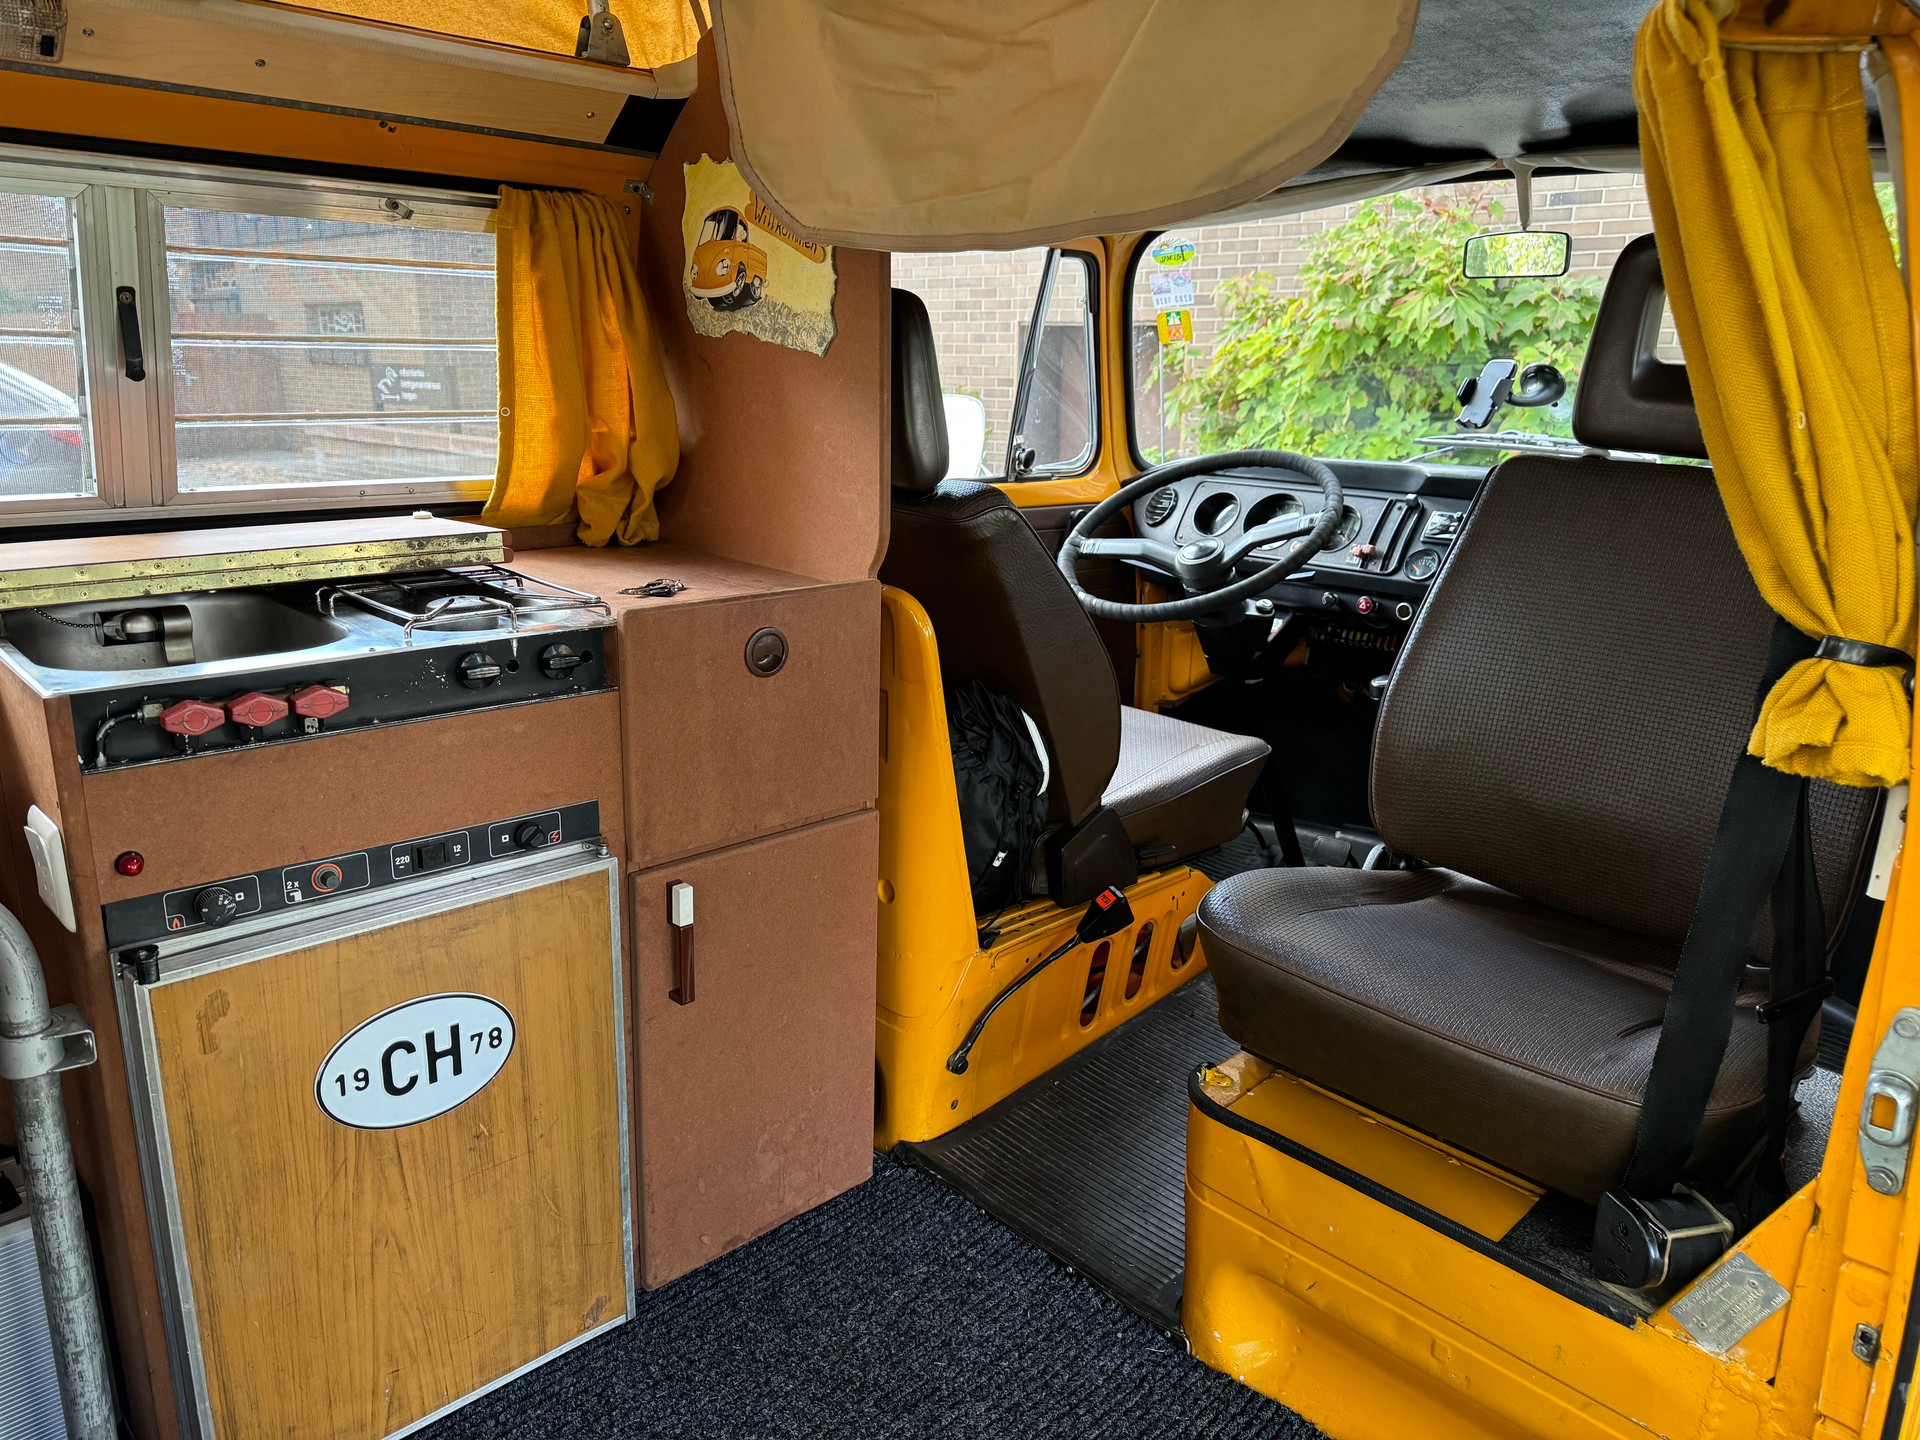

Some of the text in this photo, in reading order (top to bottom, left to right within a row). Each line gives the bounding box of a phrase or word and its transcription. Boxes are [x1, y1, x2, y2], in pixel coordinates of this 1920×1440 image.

[395, 845, 462, 865] 220 12
[287, 881, 293, 889] 2
[335, 1022, 502, 1097] 19 CH 78
